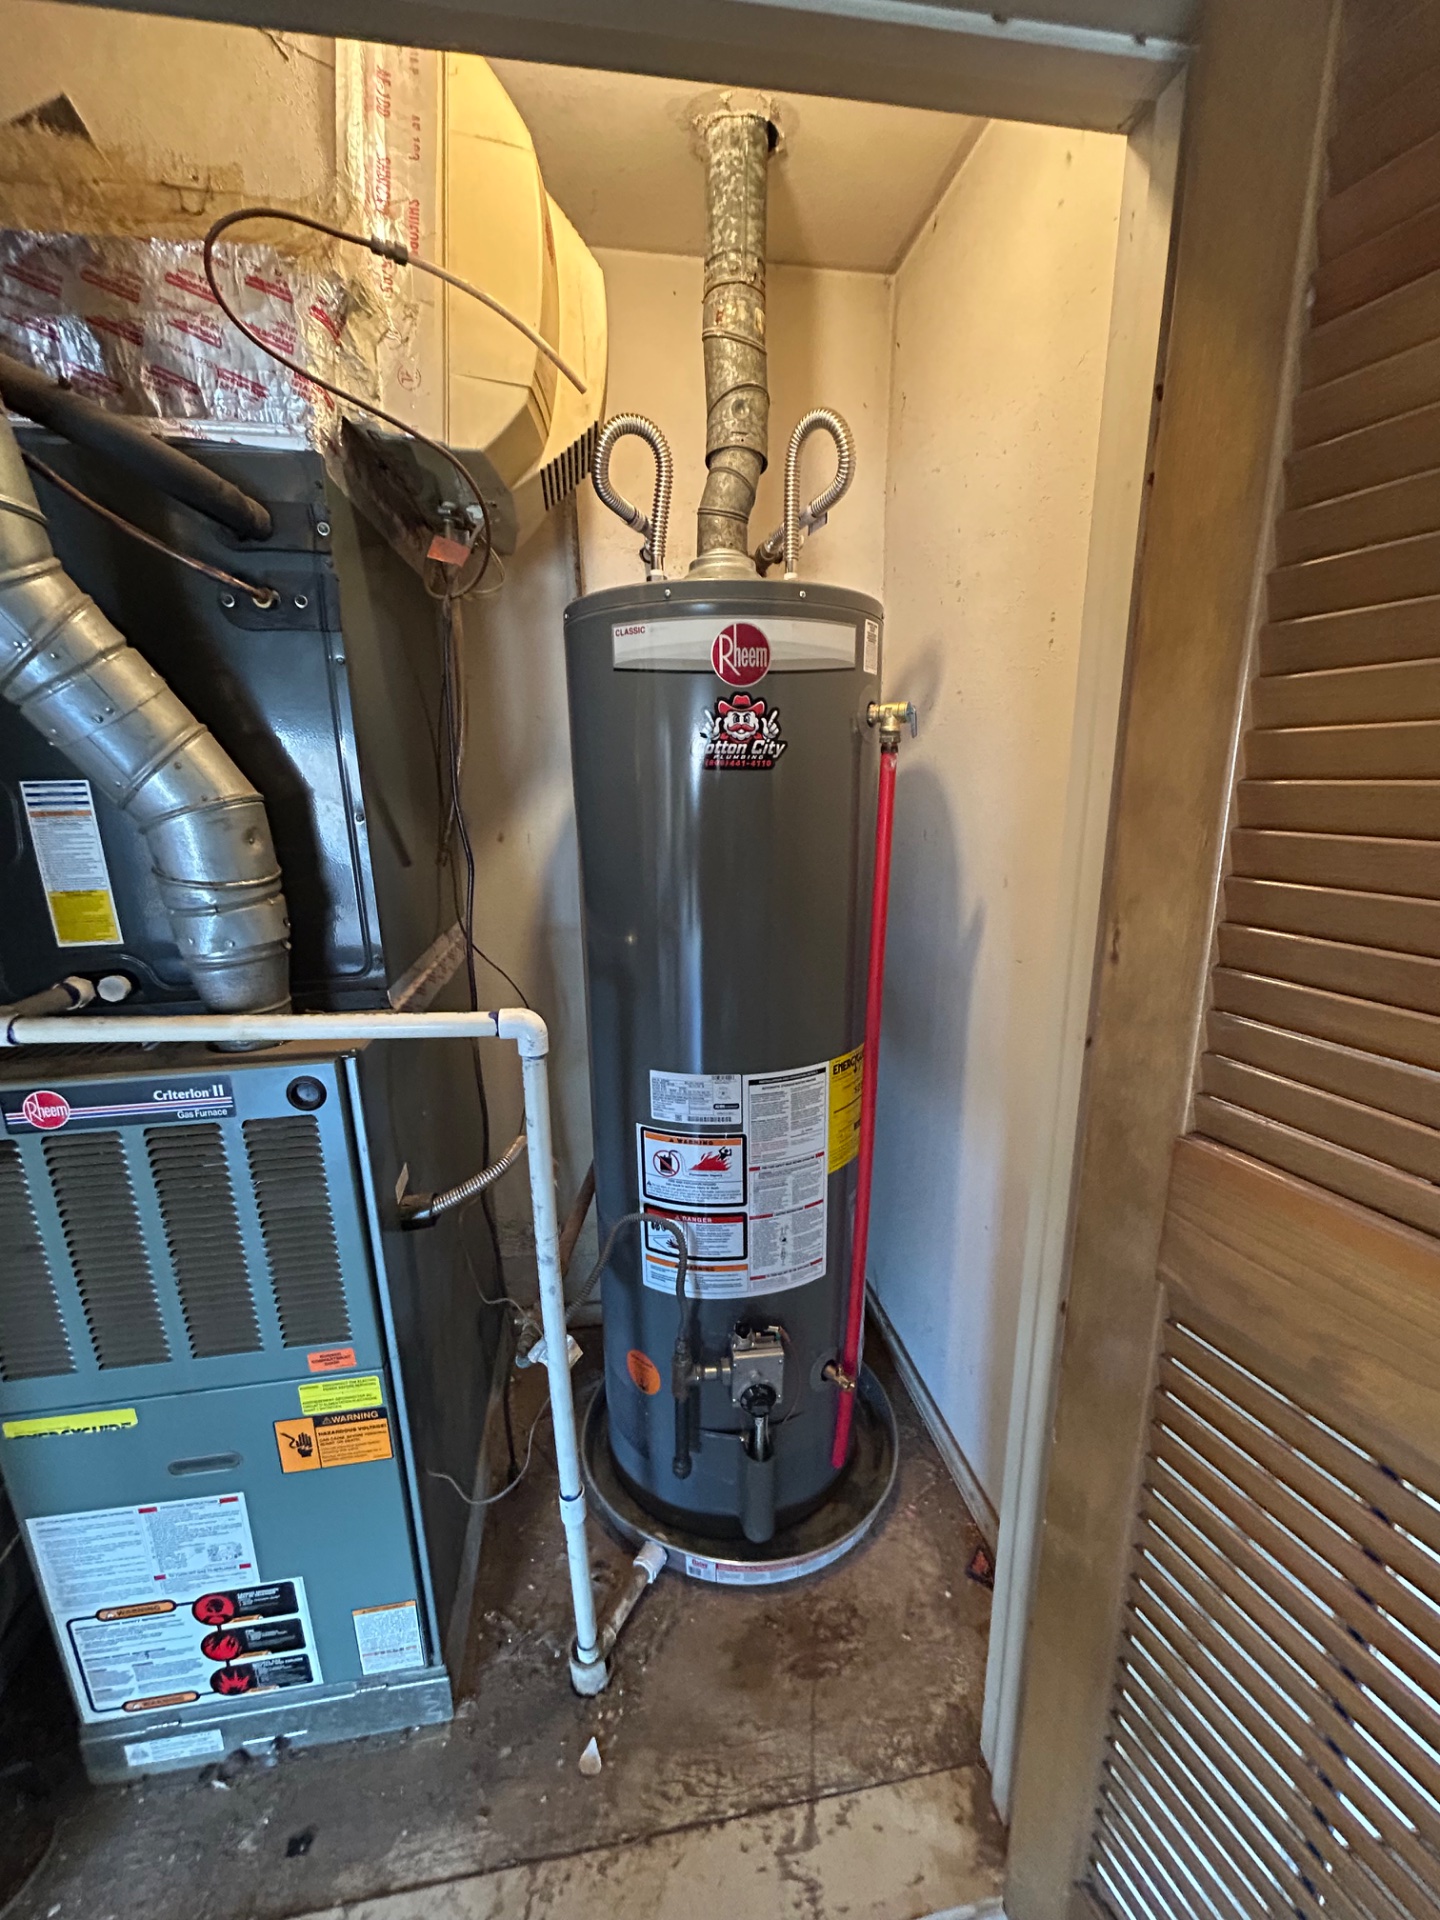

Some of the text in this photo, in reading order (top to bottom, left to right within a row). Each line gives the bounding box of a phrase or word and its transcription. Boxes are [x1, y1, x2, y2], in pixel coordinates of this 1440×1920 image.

[615, 626, 646, 637] CLASSIC
[718, 623, 769, 677] Rheem
[751, 738, 786, 758] City
[153, 1083, 225, 1101] Criterion II
[25, 1093, 69, 1123] Rheem
[177, 1108, 228, 1119] Gas Furnace
[677, 1138, 714, 1146] WARNING
[682, 1215, 713, 1223] DANGER
[331, 1410, 379, 1424] WARNING
